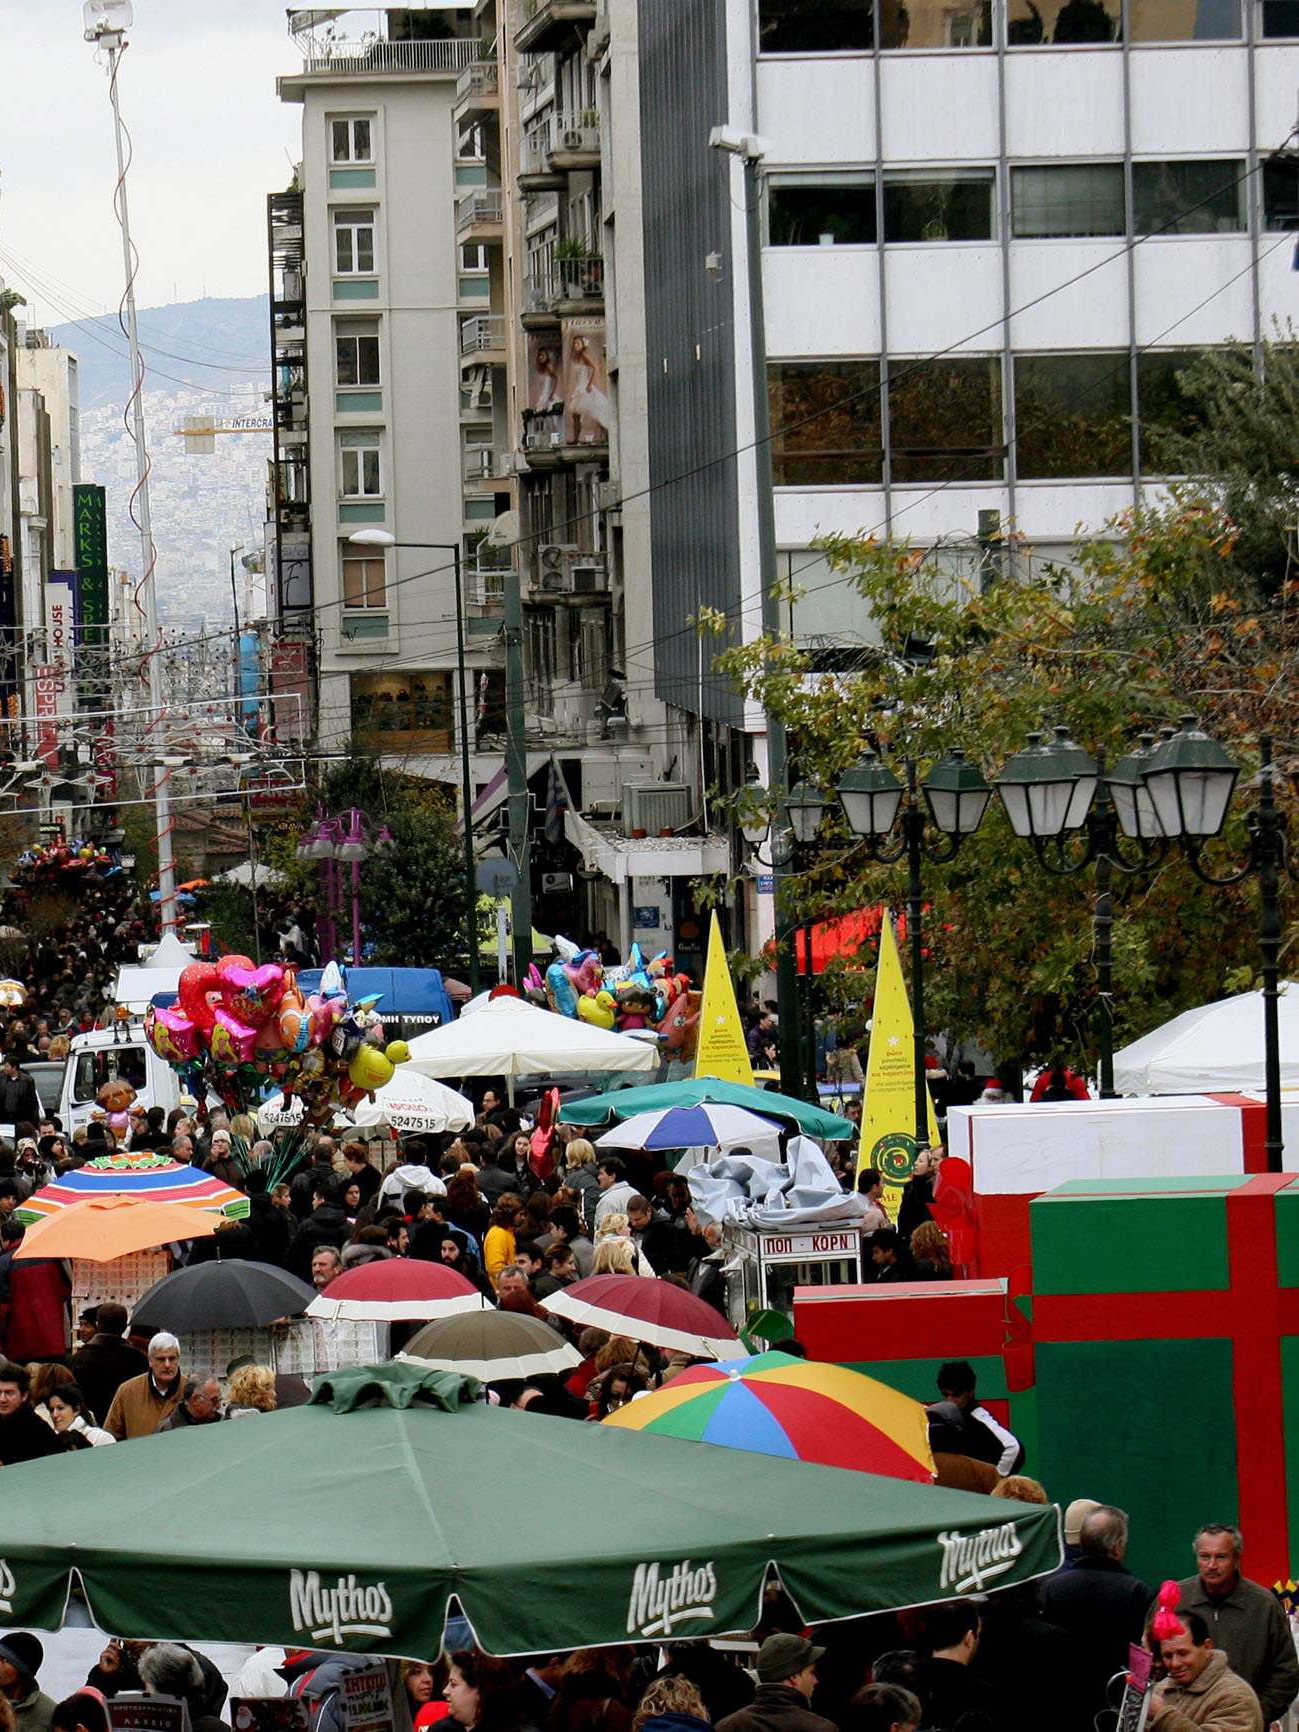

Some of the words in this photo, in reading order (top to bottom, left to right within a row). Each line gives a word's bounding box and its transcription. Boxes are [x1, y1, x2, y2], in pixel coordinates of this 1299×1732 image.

[77, 494, 94, 568] MARKS
[81, 577, 94, 591] &
[52, 604, 63, 648] HOUSE
[402, 1015, 440, 1024] ΤΥΠΟΥ
[264, 1112, 302, 1124] 5247515
[391, 1116, 436, 1130] 5247515
[767, 1237, 792, 1253] ΠΟΠ
[813, 1234, 848, 1251] ΚΟΡΝ
[937, 1521, 1023, 1591] Mythos
[289, 1568, 393, 1645] Mythos
[627, 1559, 718, 1636] Mythos
[124, 1717, 172, 1728] ΛΑΧΕΙΟ
